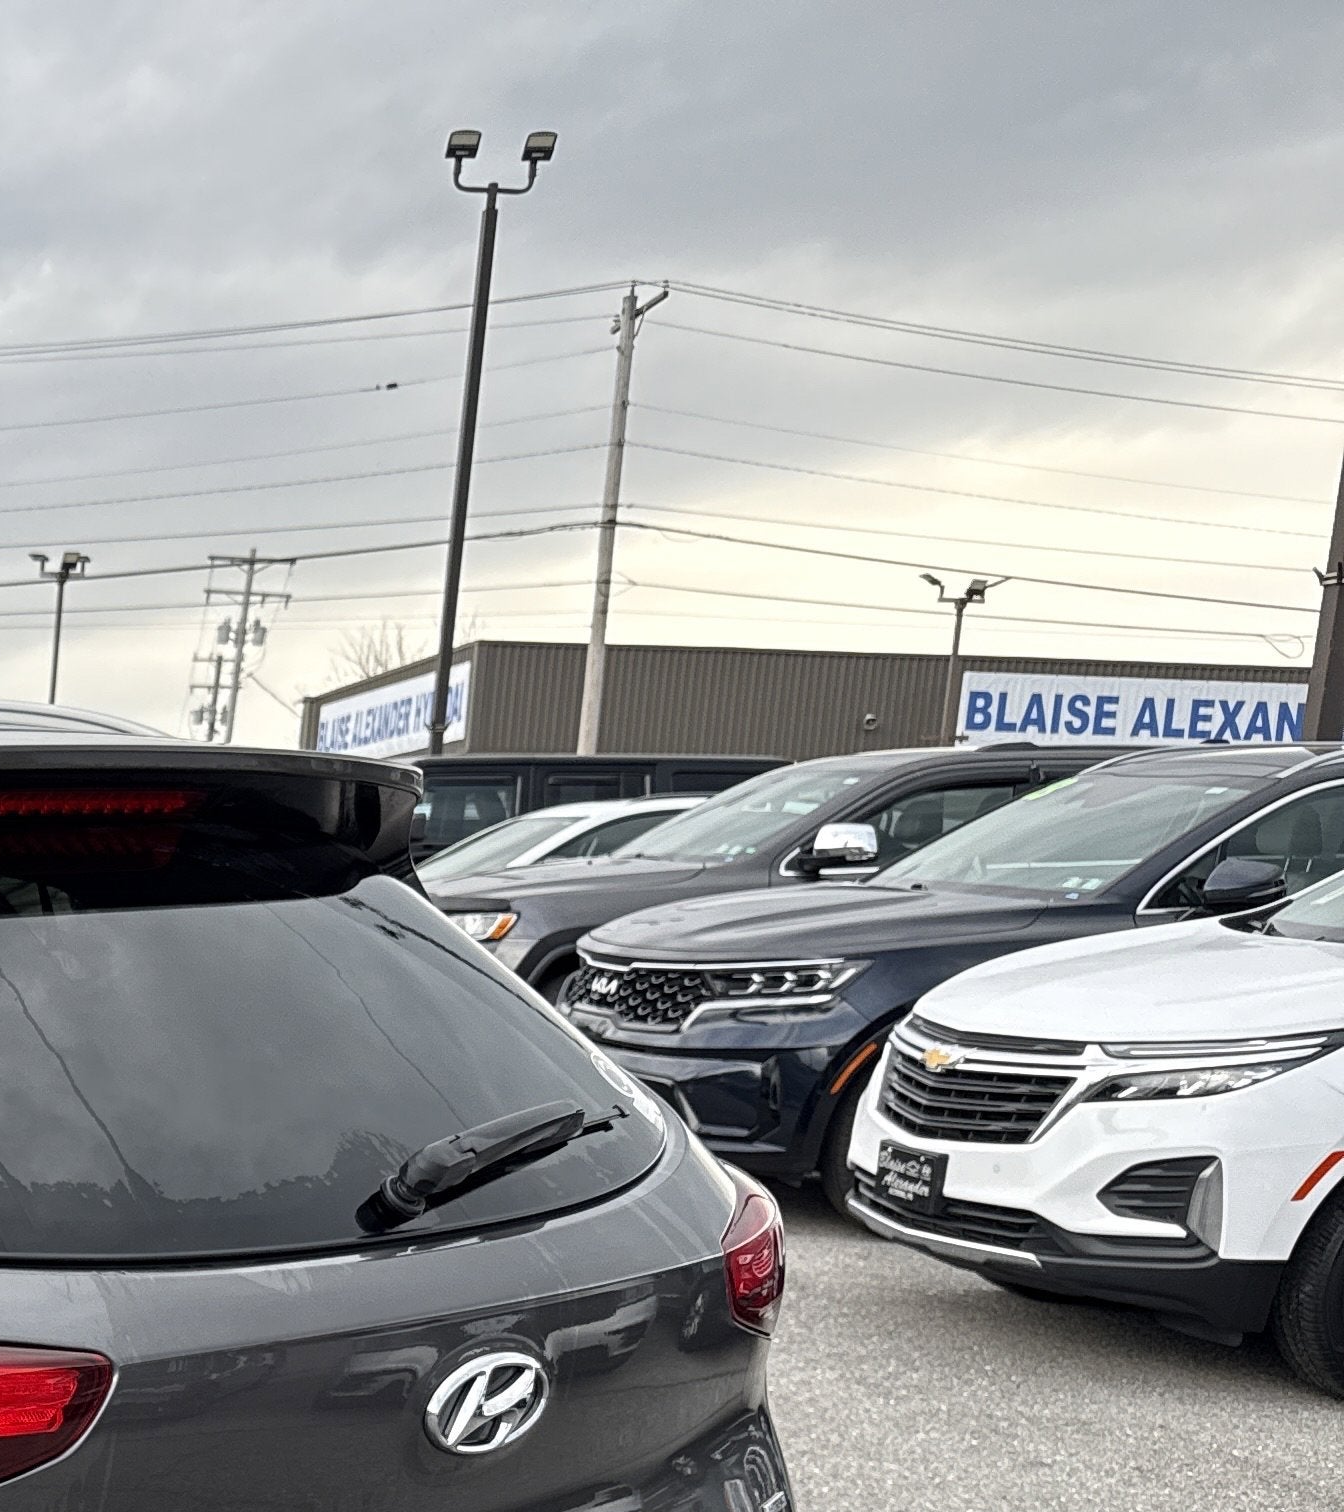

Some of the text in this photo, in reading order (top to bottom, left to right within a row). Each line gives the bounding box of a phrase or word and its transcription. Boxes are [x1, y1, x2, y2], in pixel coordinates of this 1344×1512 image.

[317, 712, 351, 751] BLAISE
[352, 697, 413, 745] ALEXANDER
[965, 691, 1119, 736] BLAISE
